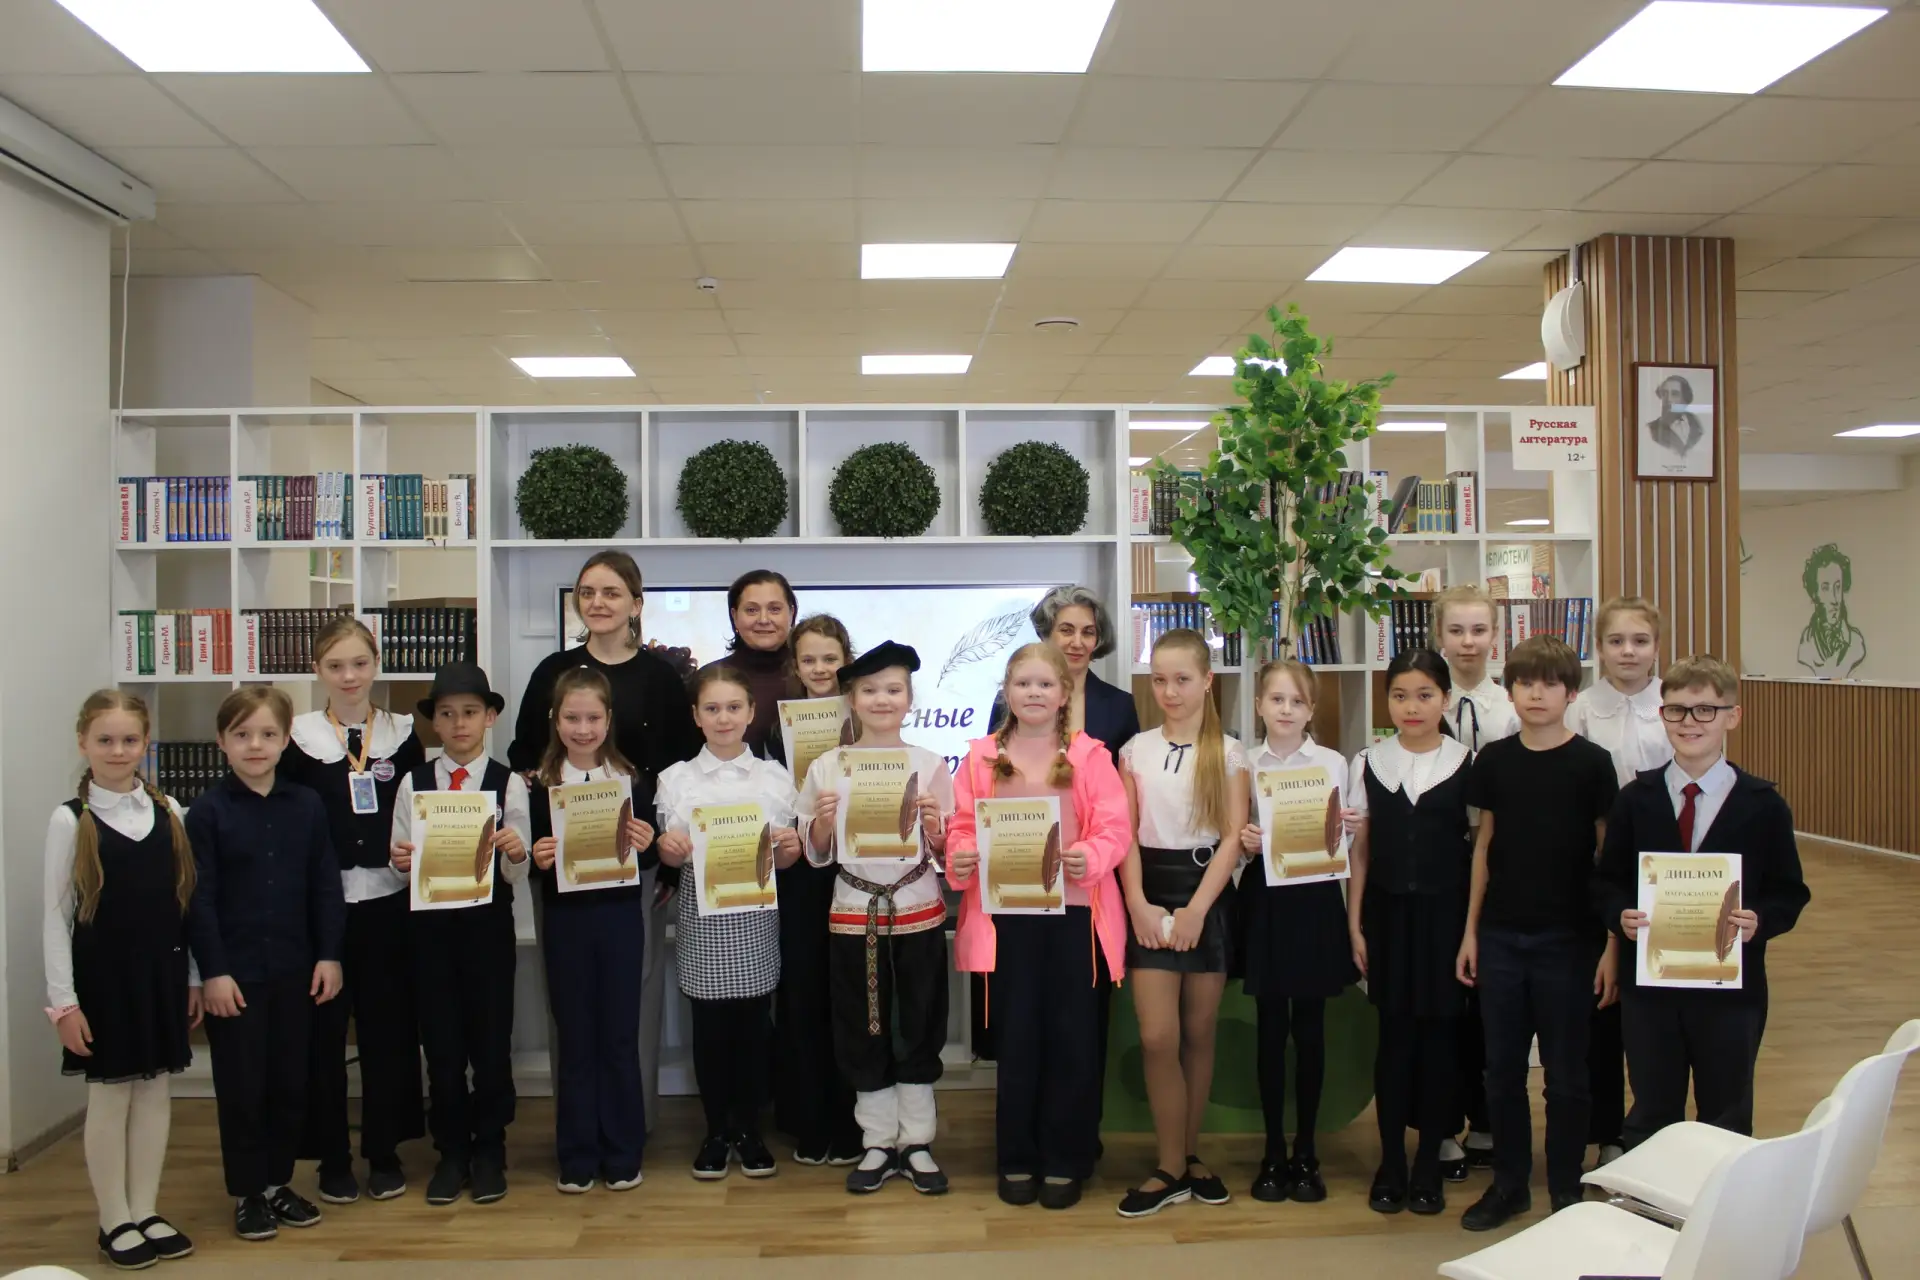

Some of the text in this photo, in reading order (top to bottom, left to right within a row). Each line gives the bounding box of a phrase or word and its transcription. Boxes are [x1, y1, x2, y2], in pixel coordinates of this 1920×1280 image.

[1529, 419, 1577, 430] Русская
[1519, 435, 1588, 446] литература
[1567, 453, 1586, 462] 12+
[366, 483, 377, 536] Булгаков М.
[454, 501, 462, 526] Быков
[1463, 499, 1472, 526] Лесков
[119, 500, 130, 541] Астафьев
[152, 498, 161, 535] Айтматов
[244, 505, 252, 533] Беляев
[161, 624, 171, 665] Гарин-М.
[124, 635, 133, 671] Васильев
[198, 643, 208, 663] Грин
[246, 631, 256, 673] Грибоедов
[795, 711, 837, 722] ДИПЛОМ
[856, 762, 905, 771] ДИПЛОМ
[1276, 778, 1325, 791] ДИПЛОМ
[570, 790, 618, 803] ДИПЛОМ
[432, 805, 482, 814] ДИПЛОМ
[711, 814, 758, 826] ДИПЛОМ
[996, 812, 1045, 822] ДИПЛОМ
[1664, 870, 1723, 879] ДИПЛОМ
